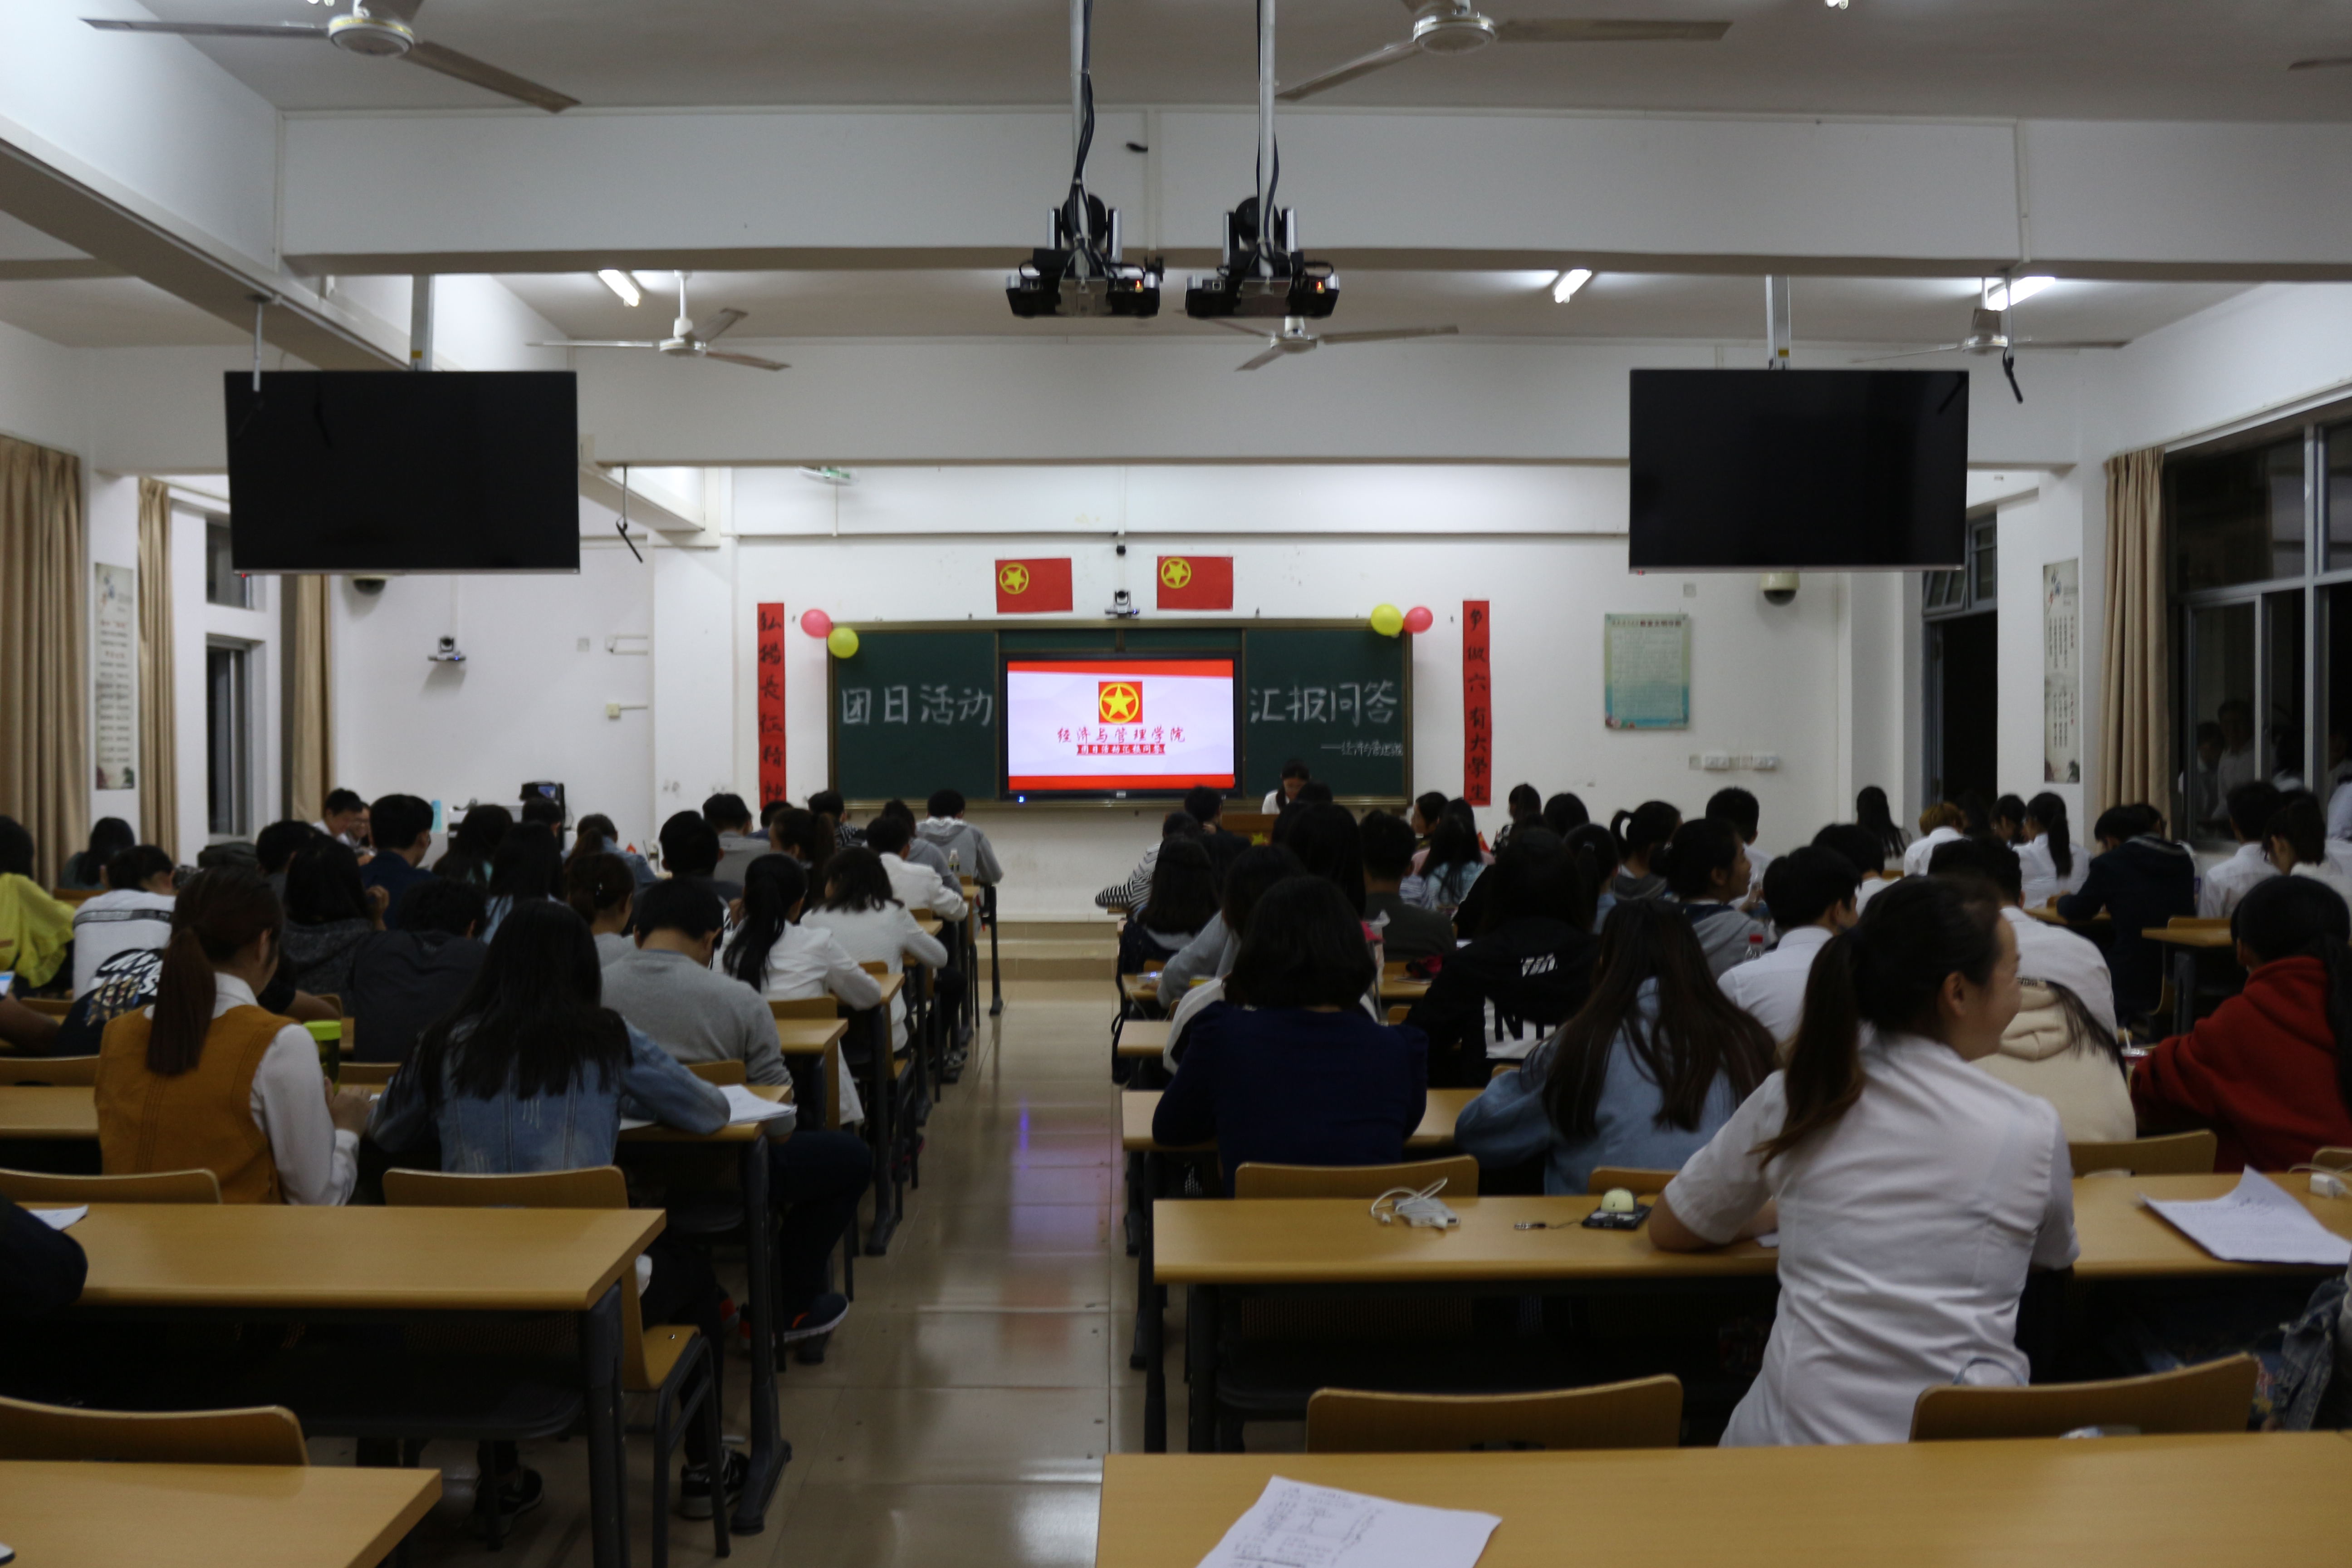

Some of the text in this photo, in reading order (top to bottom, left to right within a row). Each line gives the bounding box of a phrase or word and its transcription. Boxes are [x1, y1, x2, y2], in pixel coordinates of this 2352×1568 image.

[841, 679, 1398, 728] 团日活动 汇报问答
[1057, 725, 1186, 744] 经济与管理学院
